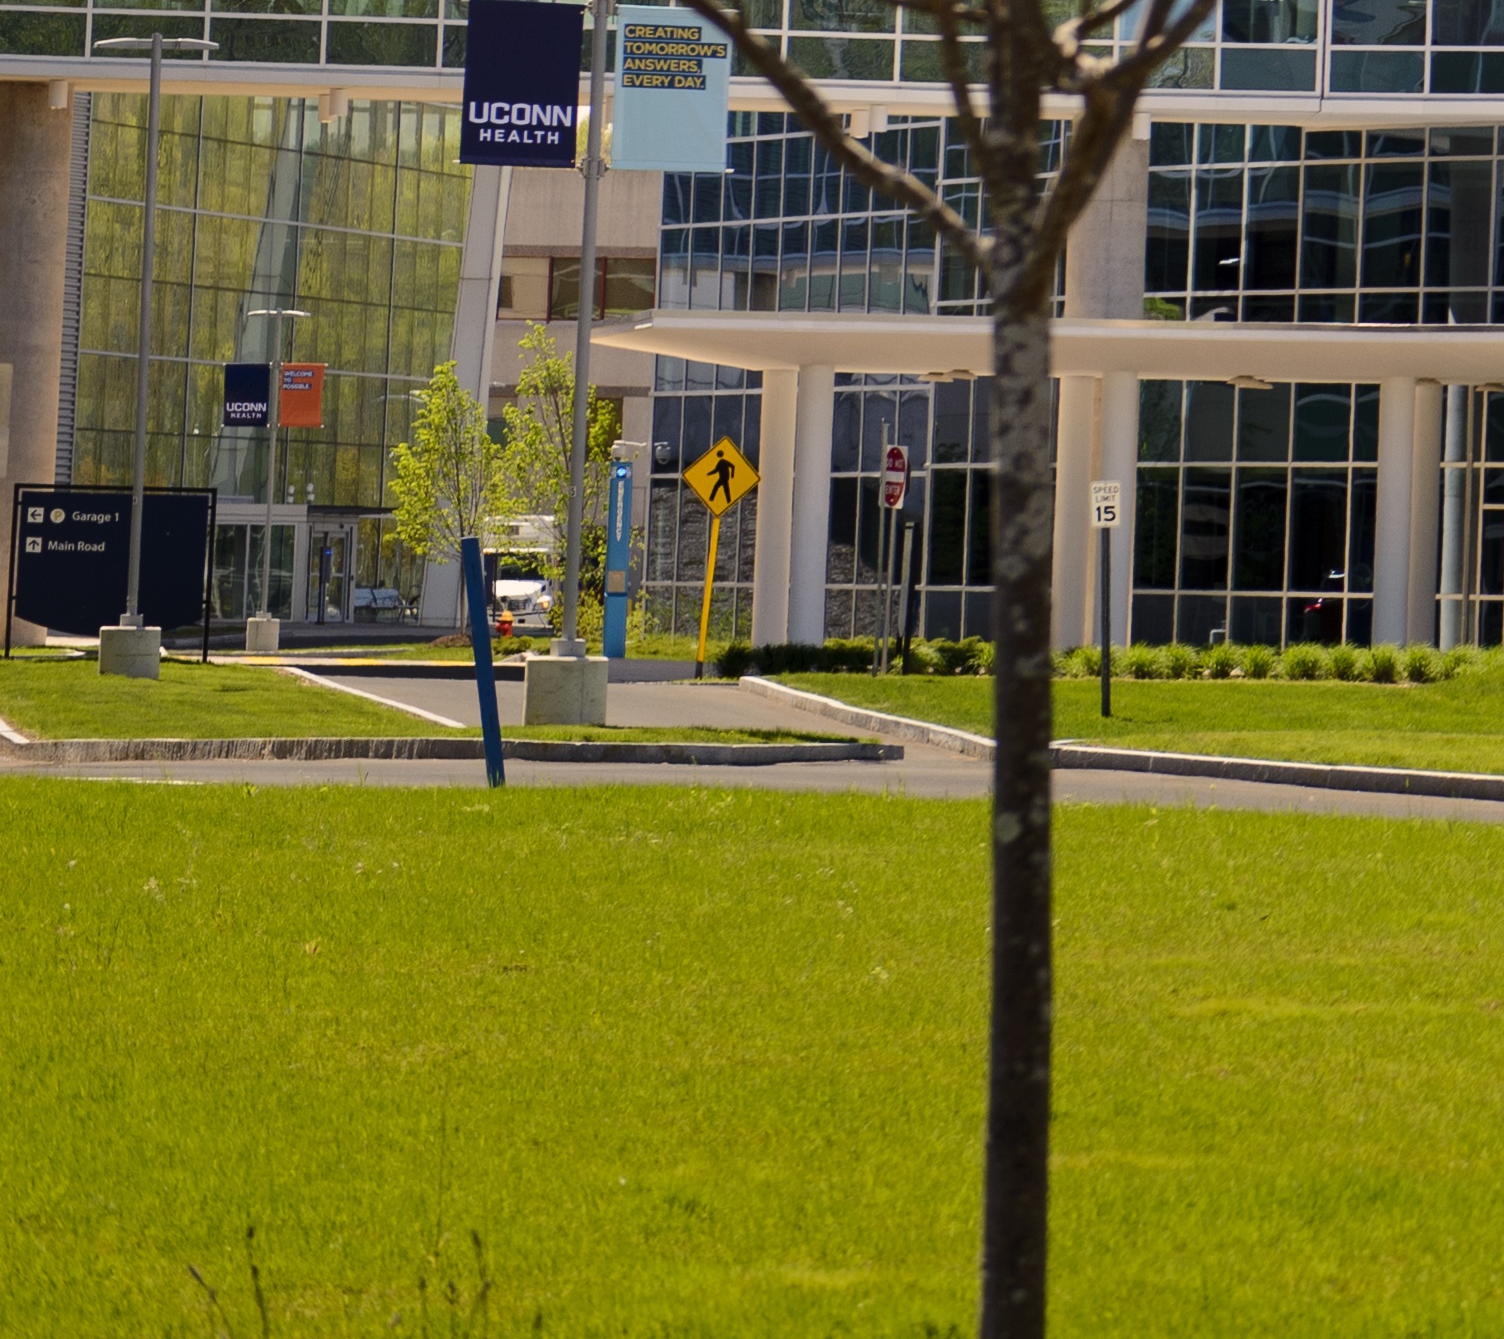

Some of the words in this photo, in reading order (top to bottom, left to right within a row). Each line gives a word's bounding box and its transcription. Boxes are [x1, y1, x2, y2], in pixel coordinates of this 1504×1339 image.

[624, 25, 699, 40] CREATING
[624, 41, 726, 57] TOMORROW'S
[623, 58, 701, 73] ANSWERS,
[623, 75, 671, 88] EVERY
[674, 76, 705, 89] DAY.
[469, 101, 572, 127] UCONN
[479, 128, 560, 145] HEALTH
[226, 403, 267, 412] UCONN
[1093, 486, 1119, 494] SPEED
[1095, 495, 1116, 503] LIMIT
[72, 511, 111, 524] Garage
[114, 512, 120, 522] 1
[1096, 505, 1116, 522] 15
[48, 540, 75, 552] Main
[77, 541, 106, 552] Road
